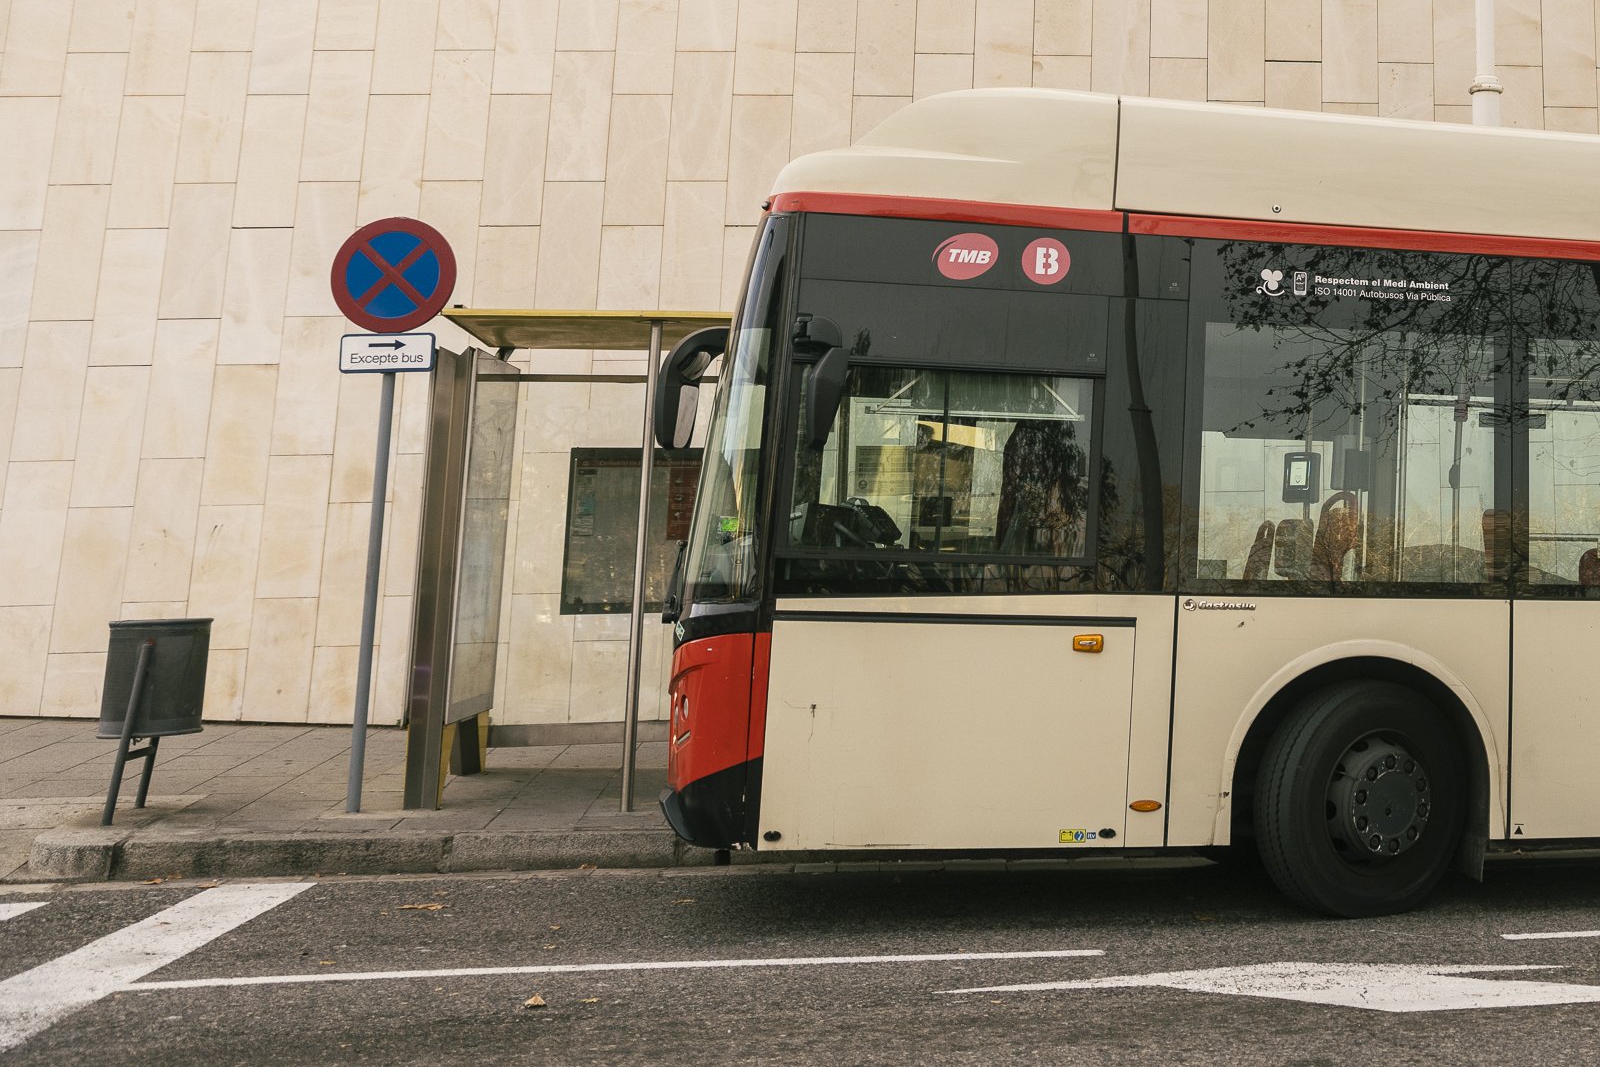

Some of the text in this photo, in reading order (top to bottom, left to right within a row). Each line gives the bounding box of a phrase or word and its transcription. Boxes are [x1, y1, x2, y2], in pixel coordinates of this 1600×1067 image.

[949, 248, 991, 264] TMB
[1035, 247, 1059, 275] B
[1315, 275, 1369, 286] Respectem
[1371, 278, 1380, 286] el
[1383, 279, 1406, 288] Medi
[1409, 281, 1449, 290] Ambient
[1315, 287, 1330, 295] ISO
[1334, 288, 1357, 297] 14001
[1359, 289, 1403, 300] Autobusos
[1421, 291, 1451, 302] Pública
[350, 353, 424, 365] Excepte bus
